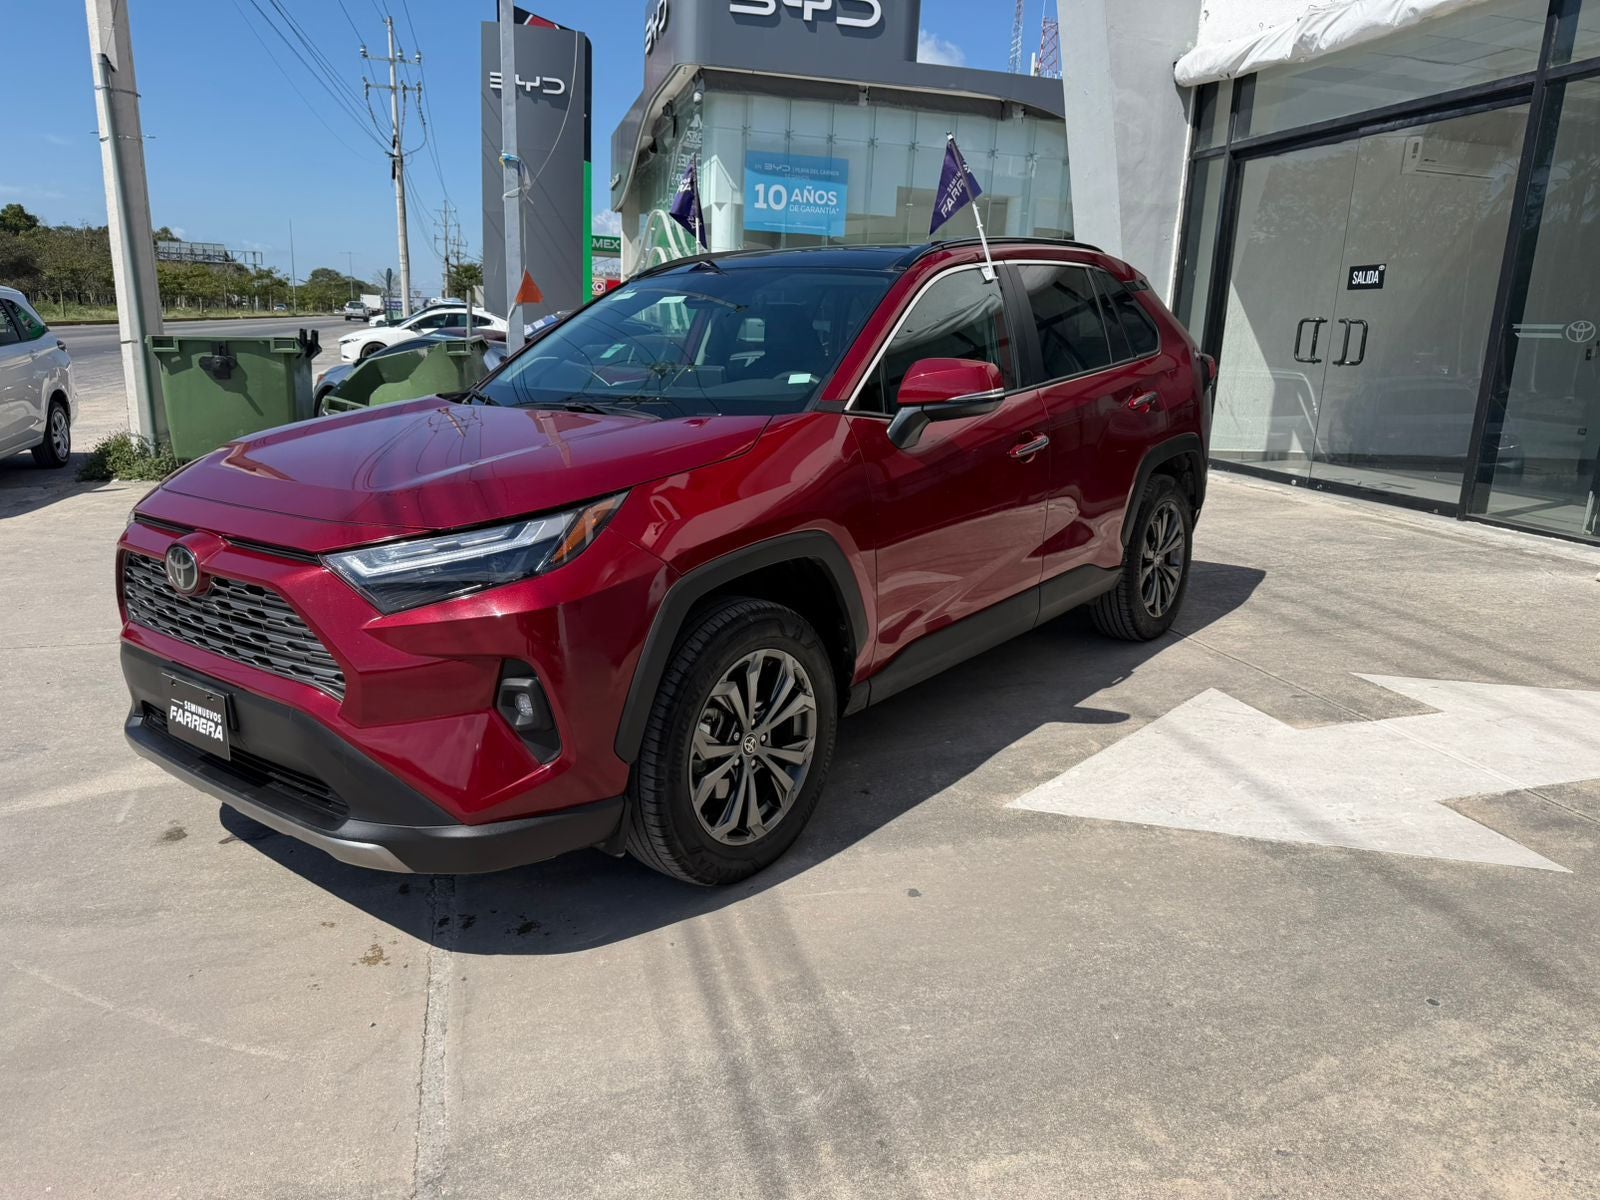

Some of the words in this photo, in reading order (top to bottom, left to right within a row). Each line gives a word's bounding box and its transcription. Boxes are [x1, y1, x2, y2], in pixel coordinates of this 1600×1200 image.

[753, 183, 788, 211] 10
[790, 186, 837, 206] AÑOS
[789, 204, 799, 213] DE
[592, 237, 620, 249] MEX
[1352, 270, 1379, 285] SALIDA
[184, 700, 222, 724] SEMINUEVOS
[170, 705, 223, 742] FARRERA
